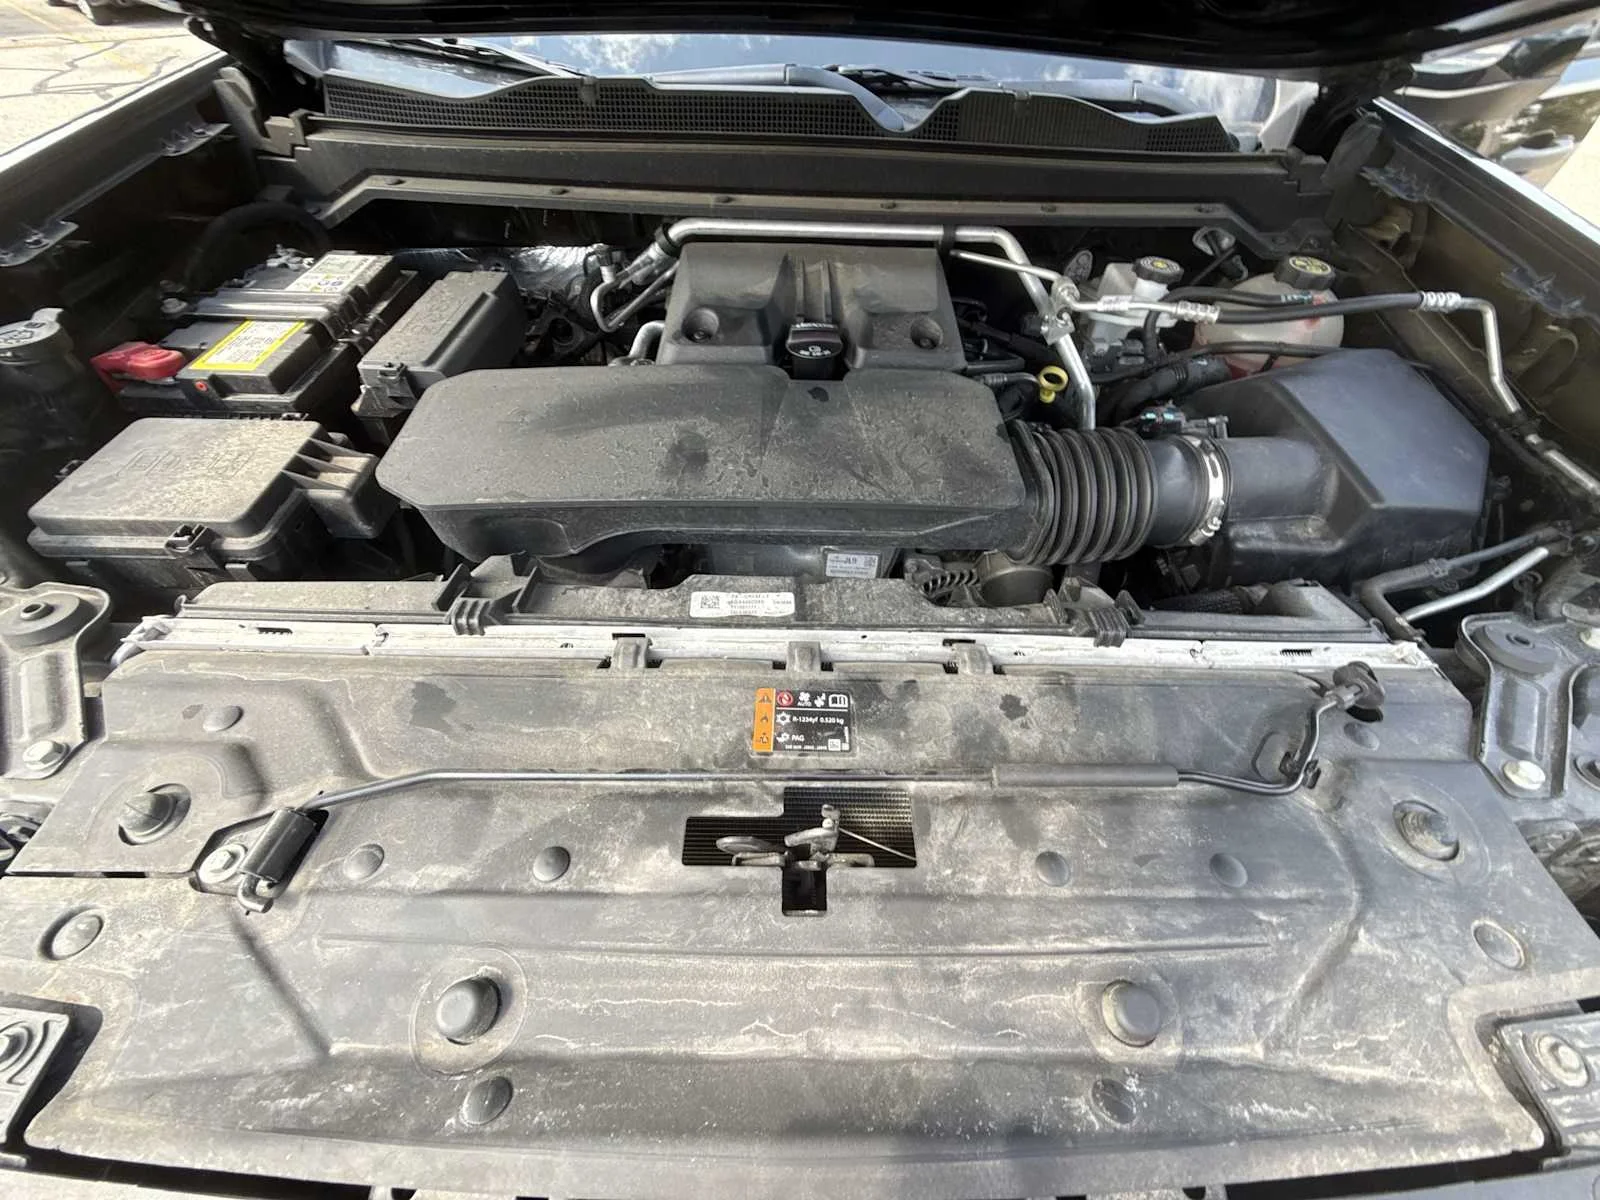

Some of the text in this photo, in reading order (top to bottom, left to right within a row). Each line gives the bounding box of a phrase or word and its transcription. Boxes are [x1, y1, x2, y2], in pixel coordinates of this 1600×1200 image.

[792, 716, 819, 724] R-1234yf
[836, 717, 845, 725] kg
[791, 734, 805, 742] PAG
